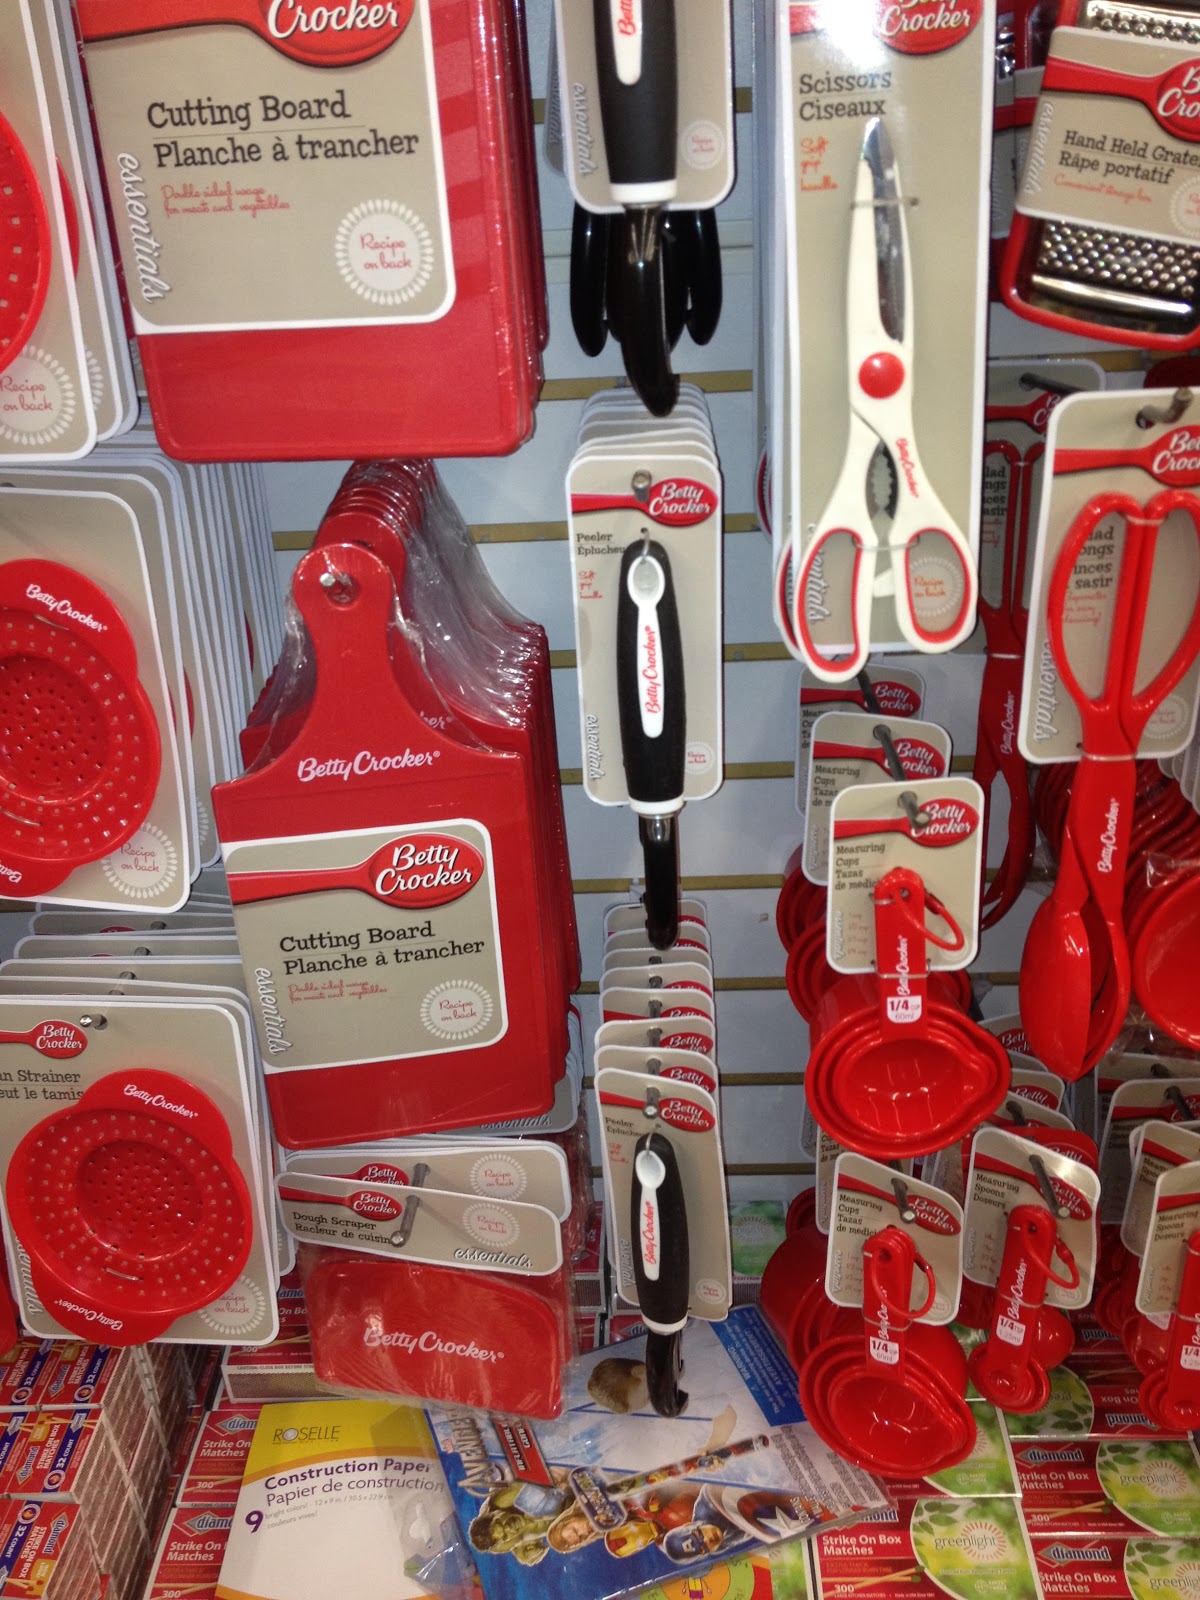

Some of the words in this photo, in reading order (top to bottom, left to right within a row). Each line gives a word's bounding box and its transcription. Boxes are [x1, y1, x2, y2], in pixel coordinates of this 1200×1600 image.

[267, 0, 398, 39] Crocker
[881, 4, 972, 37] Crocker
[799, 71, 892, 94] Scissors
[147, 101, 250, 130] Cutting
[260, 90, 351, 122] Board
[799, 100, 886, 121] Ciseaux
[153, 137, 261, 167] Planche
[272, 137, 289, 162] à
[298, 130, 419, 159] trancher
[1064, 130, 1106, 151] Hand
[1110, 138, 1149, 159] Held
[1059, 151, 1100, 172] Râpe
[1104, 162, 1175, 185] portatif
[161, 183, 199, 200] Double
[117, 152, 172, 303] essentials
[359, 232, 406, 260] Recipe
[364, 262, 379, 271] on
[380, 255, 412, 270] back
[0, 377, 46, 402] Recipe
[19, 395, 53, 411] back
[661, 482, 704, 501] Betty
[649, 497, 711, 516] Crocker
[576, 533, 613, 543] Peeler
[1075, 576, 1113, 589] sasir
[26, 585, 59, 612] Betty
[57, 599, 104, 632] Crocker
[643, 631, 659, 680] Crocker
[645, 682, 661, 714] Betty
[876, 685, 910, 700] Betty
[898, 742, 934, 762] Betty
[297, 755, 350, 782] Betty
[353, 749, 433, 775] Crocker
[815, 765, 860, 780] Measuring
[814, 776, 836, 786] Cups
[927, 803, 965, 820] Betty
[1102, 799, 1119, 847] Crocker
[120, 842, 157, 865] Recipe
[392, 843, 458, 870] Betty
[836, 843, 885, 855] Measuring
[121, 862, 134, 871] on
[134, 857, 160, 873] back
[836, 858, 859, 868] Cups
[1098, 845, 1117, 873] Betty
[375, 866, 473, 896] Crocker
[835, 870, 863, 878] Tazas
[835, 880, 846, 890] de
[280, 932, 361, 953] Cutting
[367, 920, 435, 945] Board
[283, 955, 367, 975] Planche
[375, 950, 388, 966] à
[394, 939, 485, 963] trancher
[254, 968, 293, 1055] essentials
[438, 1000, 474, 1014] Recipe
[889, 1000, 909, 1012] 1/4
[453, 1010, 478, 1021] back
[895, 1011, 915, 1021] 60ml
[43, 1024, 75, 1041] Betty
[36, 1036, 82, 1050] Crocker
[669, 1036, 702, 1048] Betty
[17, 1069, 81, 1083] Strainer
[670, 1069, 704, 1083] Betty
[24, 1087, 38, 1100] le
[124, 1083, 153, 1105] Betty
[152, 1094, 195, 1119] Crocker
[669, 1100, 703, 1117] Betty
[605, 1117, 634, 1128] Peeler
[661, 1107, 709, 1128] Crocker
[368, 1166, 397, 1181] Betty
[484, 1170, 511, 1185] Recipe
[975, 1184, 1005, 1198] Spoons
[976, 1173, 1020, 1193] Measuring
[353, 1200, 397, 1215] Crocker
[361, 1193, 390, 1208] Betty
[839, 1194, 883, 1212] Measuring
[974, 1193, 1007, 1209] Doseurs
[838, 1204, 860, 1216] Cups
[915, 1198, 949, 1222] Betty
[1158, 1211, 1198, 1222] Measuring
[292, 1212, 328, 1225] Dough
[331, 1217, 377, 1231] Scraper
[477, 1216, 505, 1229] Recipe
[642, 1206, 654, 1243] Crocker
[838, 1214, 863, 1225] Tazas
[1157, 1221, 1185, 1231] Spoons
[295, 1223, 337, 1237] Racleur
[341, 1229, 354, 1239] de
[836, 1224, 847, 1233] de
[454, 1248, 533, 1268] essentials
[644, 1241, 657, 1265] Betty
[226, 1302, 250, 1314] back
[1000, 1317, 1015, 1330] 1/4
[363, 1328, 418, 1355] Betty
[418, 1331, 497, 1363] Crocker
[871, 1340, 888, 1353] 1/4
[86, 1374, 96, 1384] 32
[93, 1358, 103, 1375] COUNT
[24, 1376, 35, 1386] 32
[273, 1426, 341, 1441] ROSELLE
[203, 1440, 233, 1449] Strike
[236, 1440, 251, 1448] On
[44, 1439, 60, 1469] MATCHES
[56, 1457, 67, 1468] 32
[63, 1439, 74, 1458] COUNT
[200, 1449, 245, 1457] Matches
[1028, 1449, 1085, 1462] diamond
[265, 1461, 378, 1490] Construction
[384, 1459, 431, 1474] Paper
[1050, 1472, 1065, 1481] On
[1067, 1472, 1089, 1481] Box
[1120, 1472, 1178, 1486] greenlight
[197, 1481, 215, 1489] 300
[266, 1486, 317, 1507] Papier
[322, 1479, 343, 1493] de
[347, 1478, 445, 1493] construction
[245, 1510, 264, 1534] 9
[267, 1517, 297, 1529] couleurs
[1031, 1513, 1049, 1522] 300
[14, 1525, 27, 1538] 32
[822, 1534, 857, 1545] Strike
[859, 1534, 875, 1545] On
[876, 1534, 902, 1545] Box
[5, 1537, 18, 1558] COUNT
[20, 1526, 41, 1560] MATCHES
[169, 1542, 203, 1551] Strike
[205, 1541, 222, 1550] On
[935, 1534, 997, 1549] greenlight
[166, 1552, 215, 1561] Matches
[823, 1545, 874, 1556] Matches
[1051, 1546, 1112, 1562] diamond
[1074, 1572, 1093, 1582] On
[1094, 1572, 1117, 1582] Box
[162, 1590, 181, 1599] 300
[834, 1584, 855, 1592] 300
